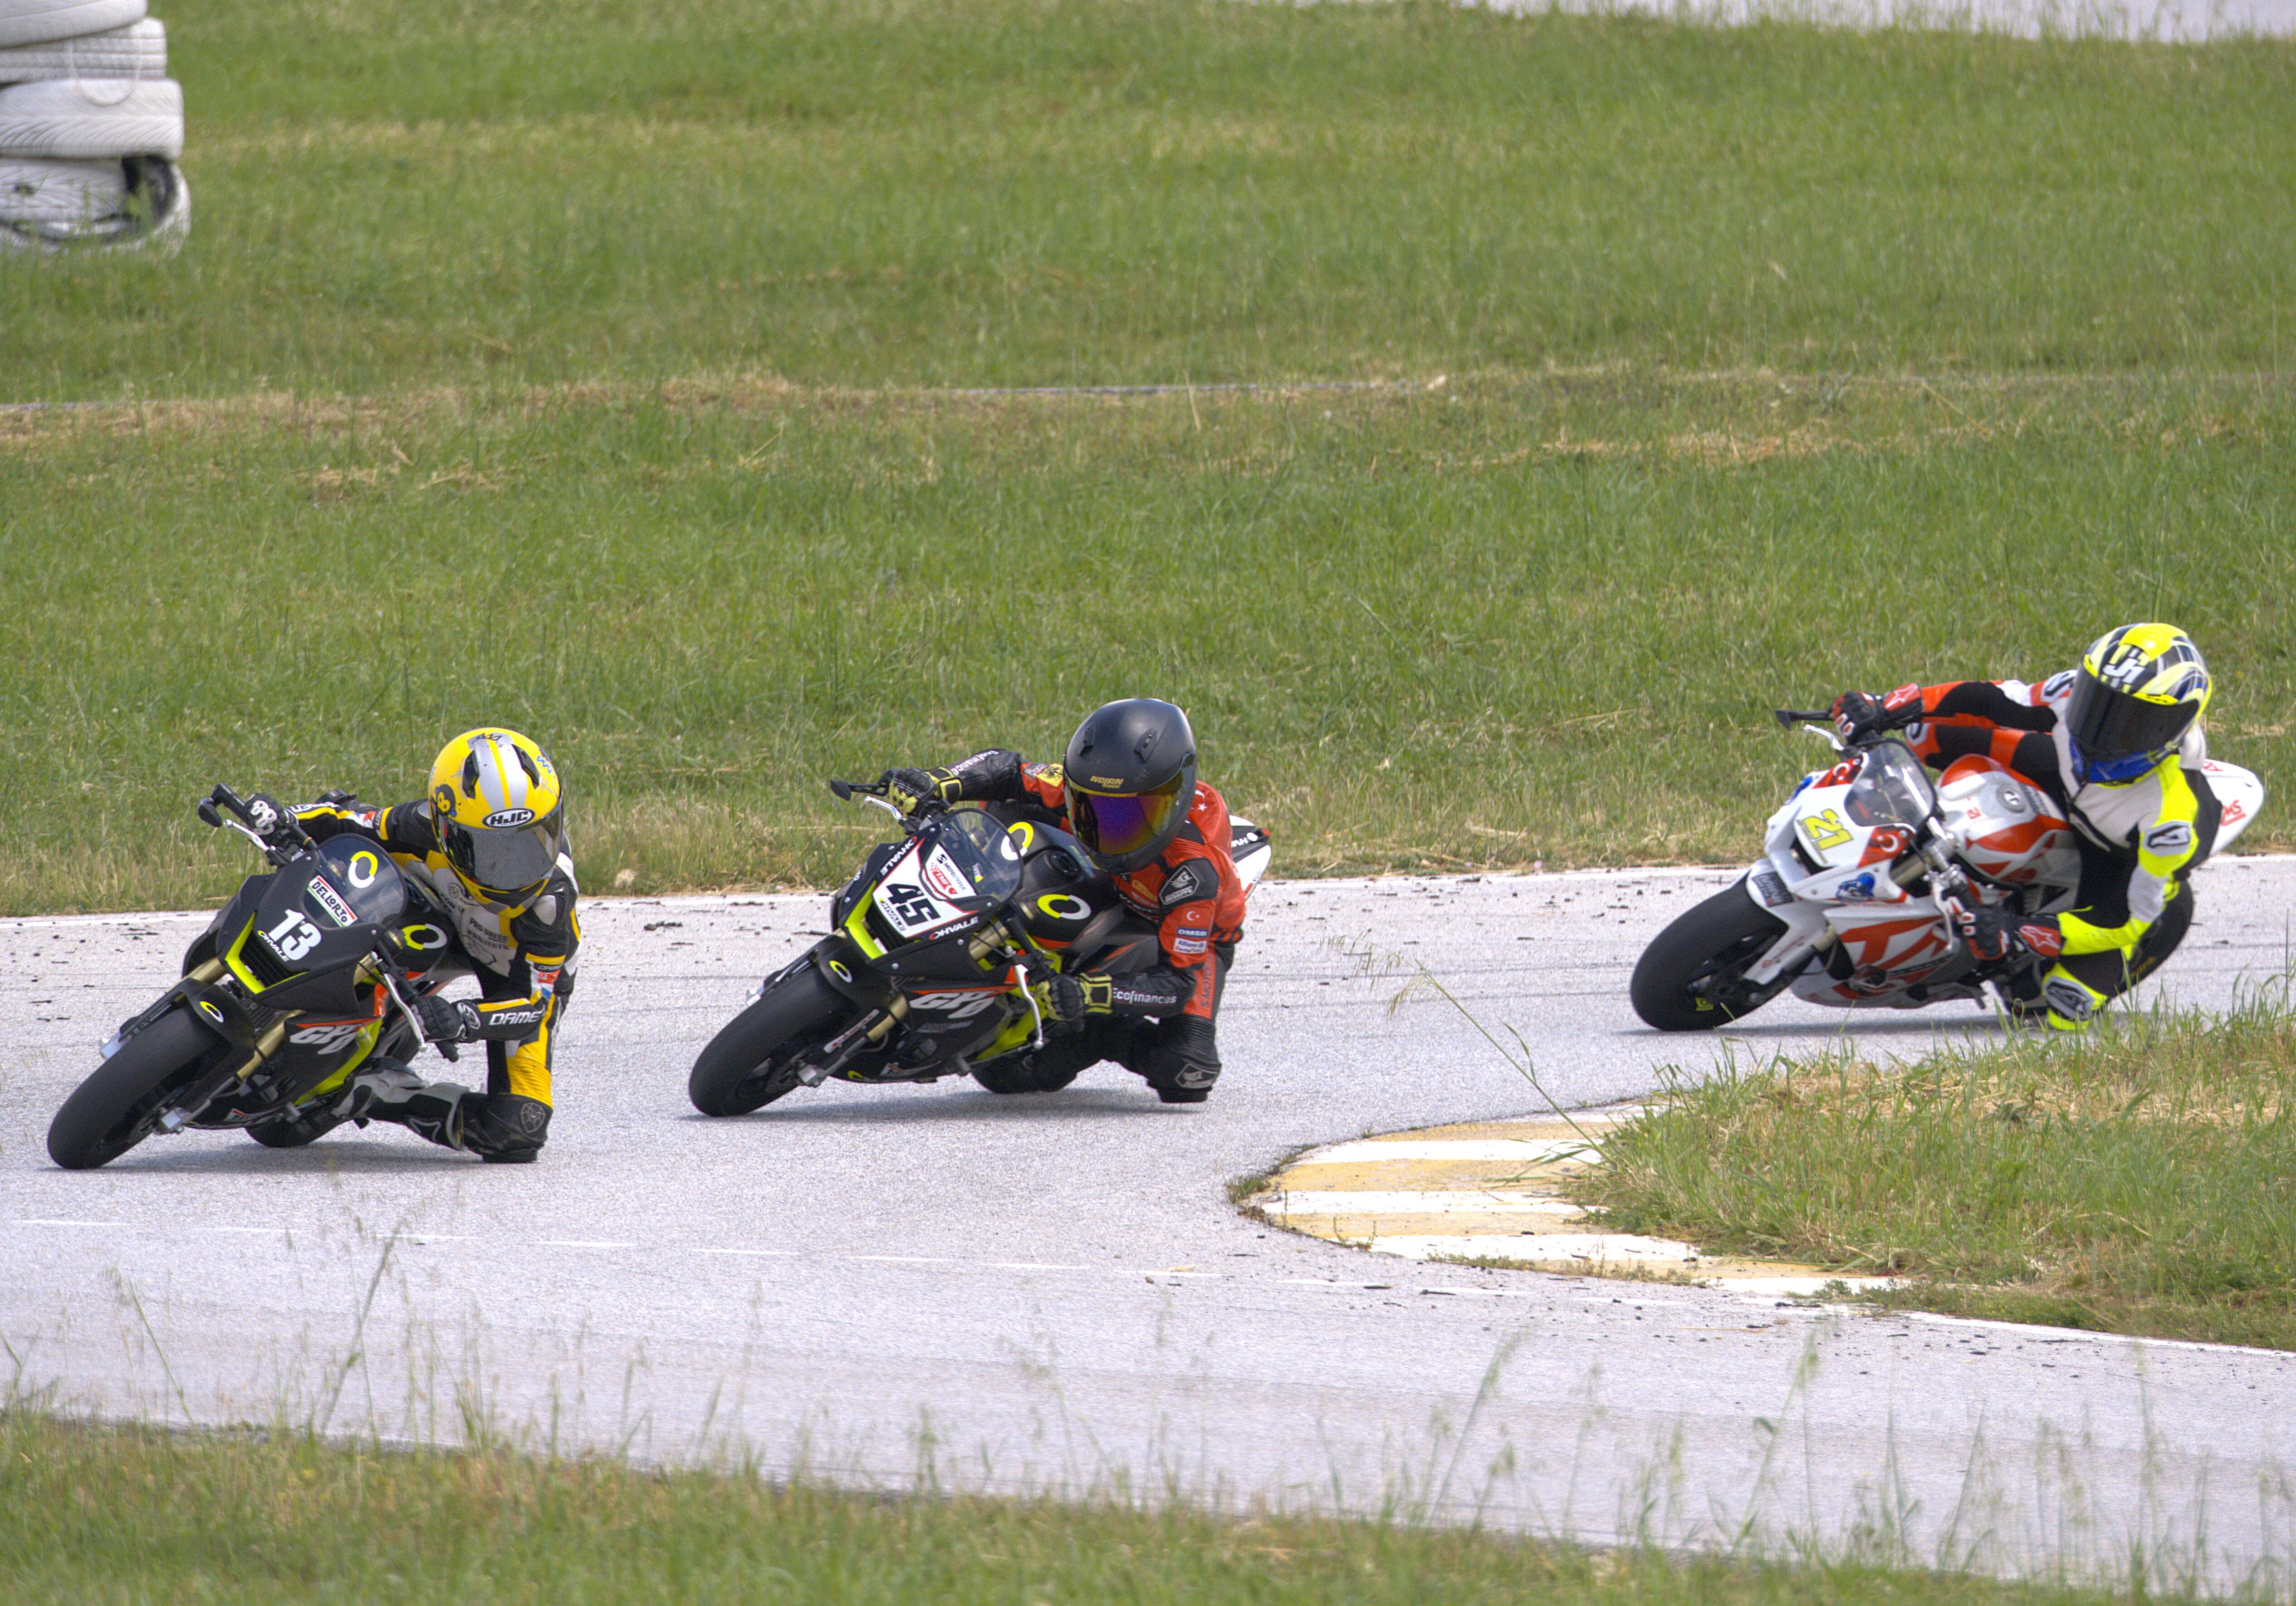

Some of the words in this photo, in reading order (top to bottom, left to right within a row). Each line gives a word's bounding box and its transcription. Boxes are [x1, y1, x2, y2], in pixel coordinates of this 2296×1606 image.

[1090, 775, 1124, 785] NOLAN
[490, 810, 529, 826] HJC
[1804, 808, 1854, 851] 21
[880, 835, 918, 876] OHVALE
[310, 881, 348, 923] DELLORTO
[878, 898, 906, 931] OHVALE
[886, 883, 942, 927] 45
[268, 909, 323, 960] 13
[929, 915, 979, 940] OHVALE
[258, 930, 290, 962] OHVALE
[489, 1007, 545, 1026] DAME
